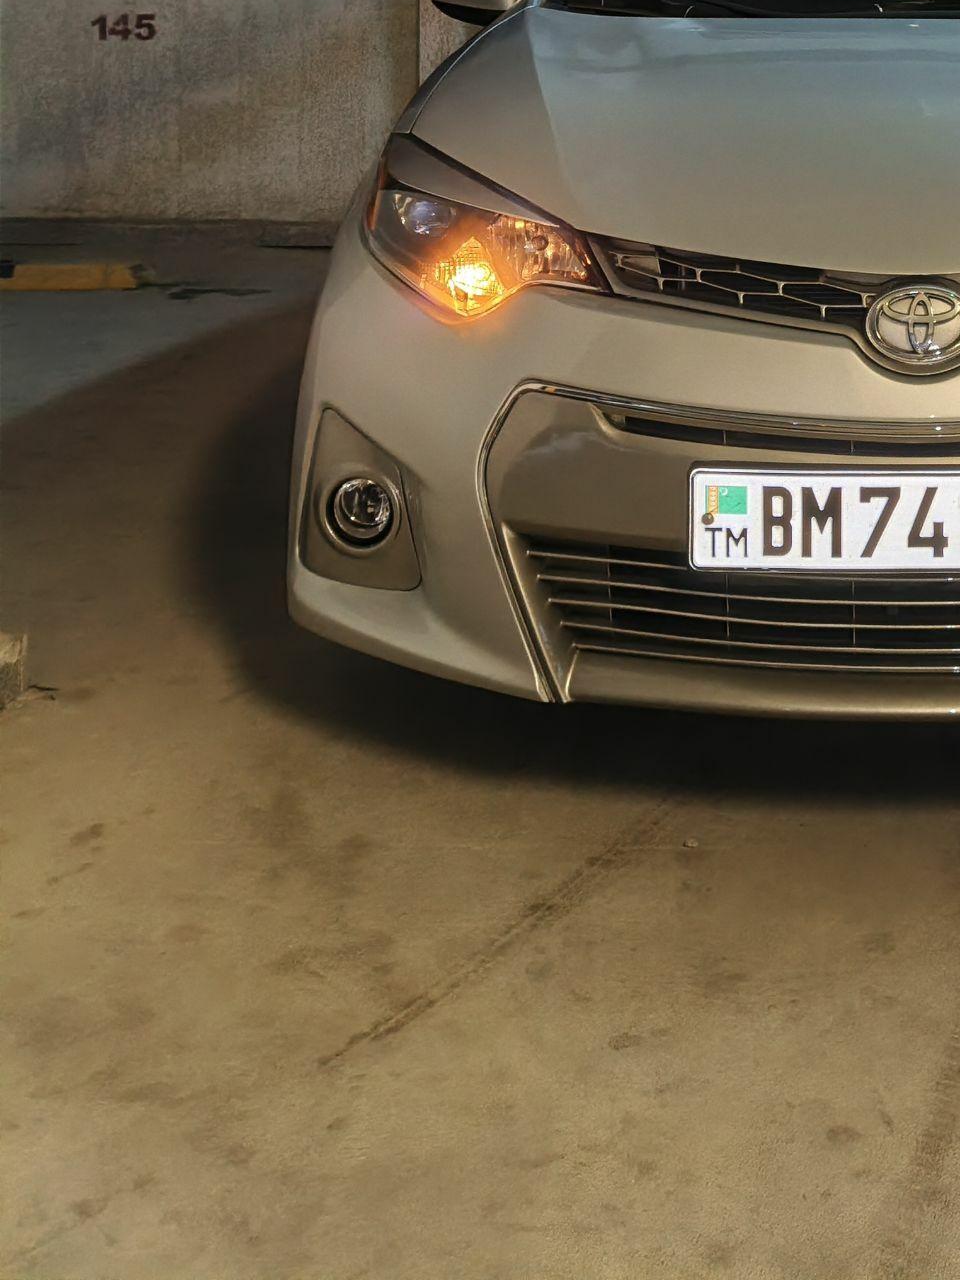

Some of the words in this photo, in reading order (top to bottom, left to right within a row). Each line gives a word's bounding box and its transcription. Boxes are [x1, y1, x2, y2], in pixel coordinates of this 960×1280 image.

[91, 14, 157, 41] 145
[762, 486, 842, 558] BM
[705, 527, 748, 558] TM
